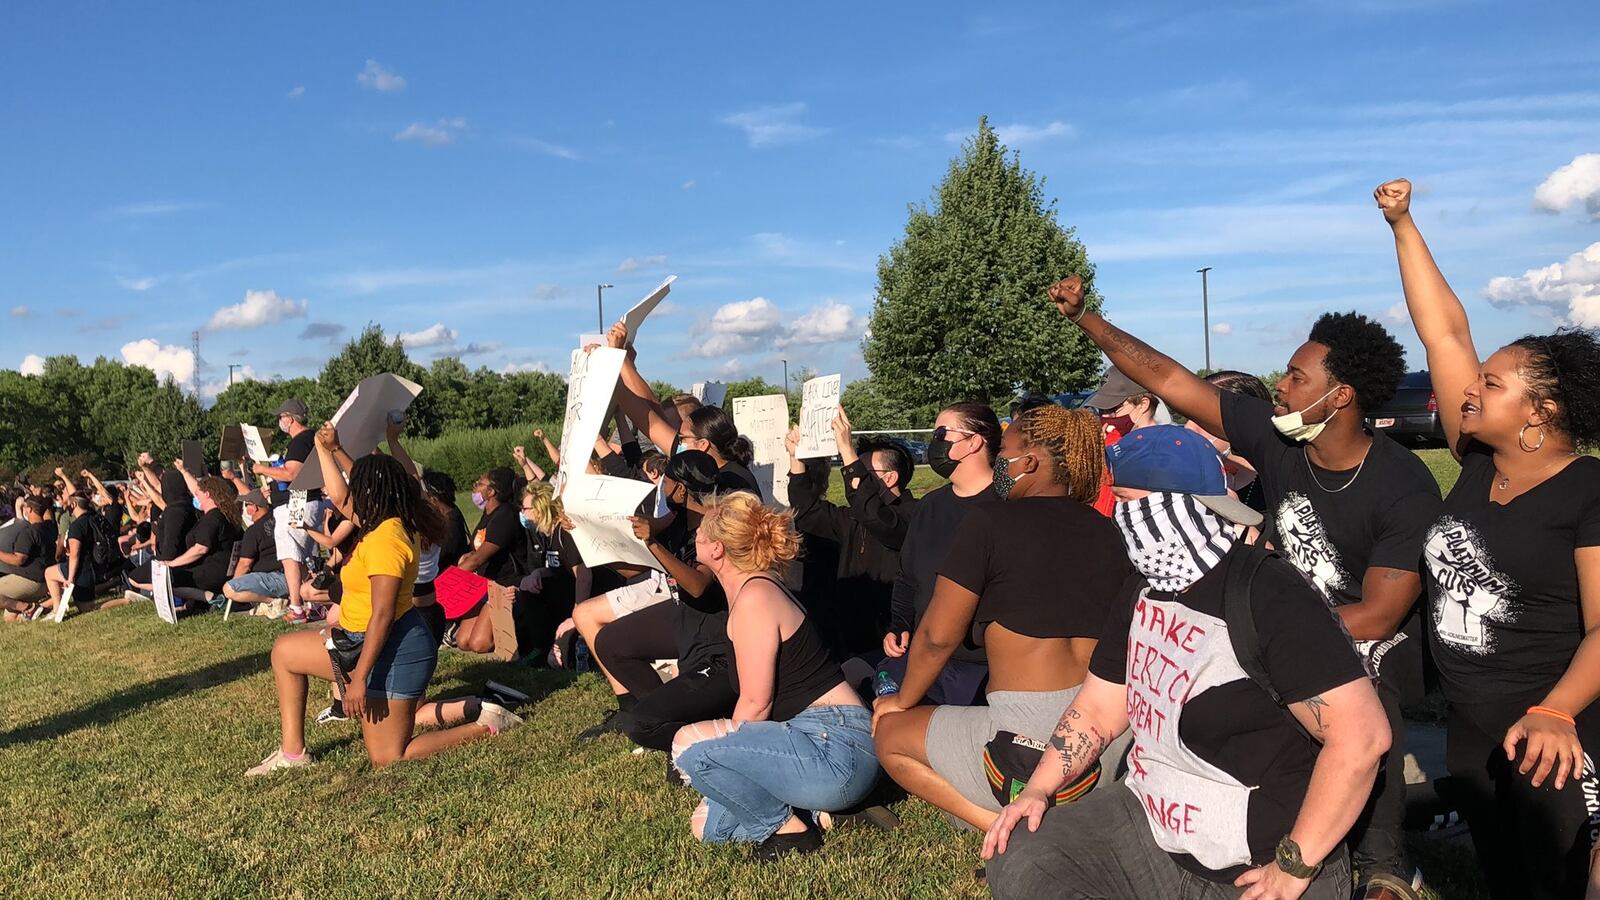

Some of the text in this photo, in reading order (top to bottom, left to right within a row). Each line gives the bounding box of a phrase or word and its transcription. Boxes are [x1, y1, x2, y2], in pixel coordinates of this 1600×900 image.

[1437, 567, 1476, 597] CUTS
[1442, 530, 1507, 594] PLATINUM
[1127, 683, 1166, 743] GREAT
